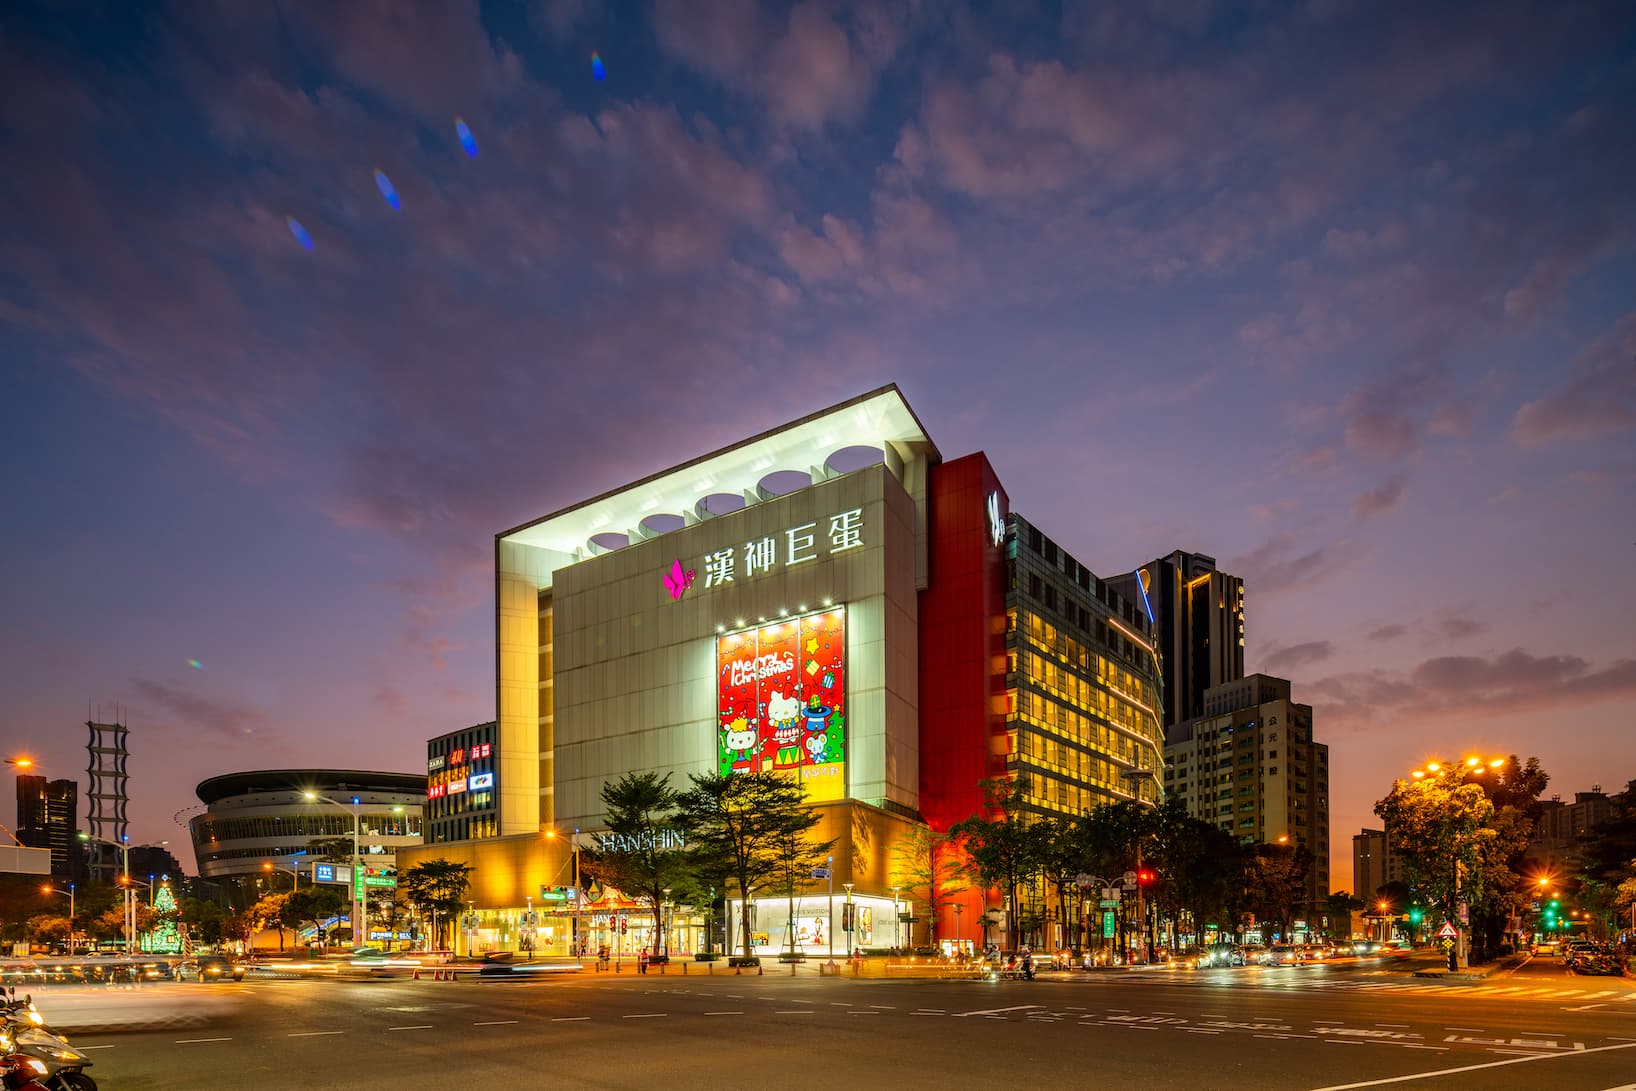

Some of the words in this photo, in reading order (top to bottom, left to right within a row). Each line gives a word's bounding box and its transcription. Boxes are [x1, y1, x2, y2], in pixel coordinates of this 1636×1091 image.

[704, 508, 865, 588] 漢神巨蛋
[731, 651, 778, 685] Merry
[734, 657, 795, 686] Christmas
[601, 828, 685, 852] HANSHIN
